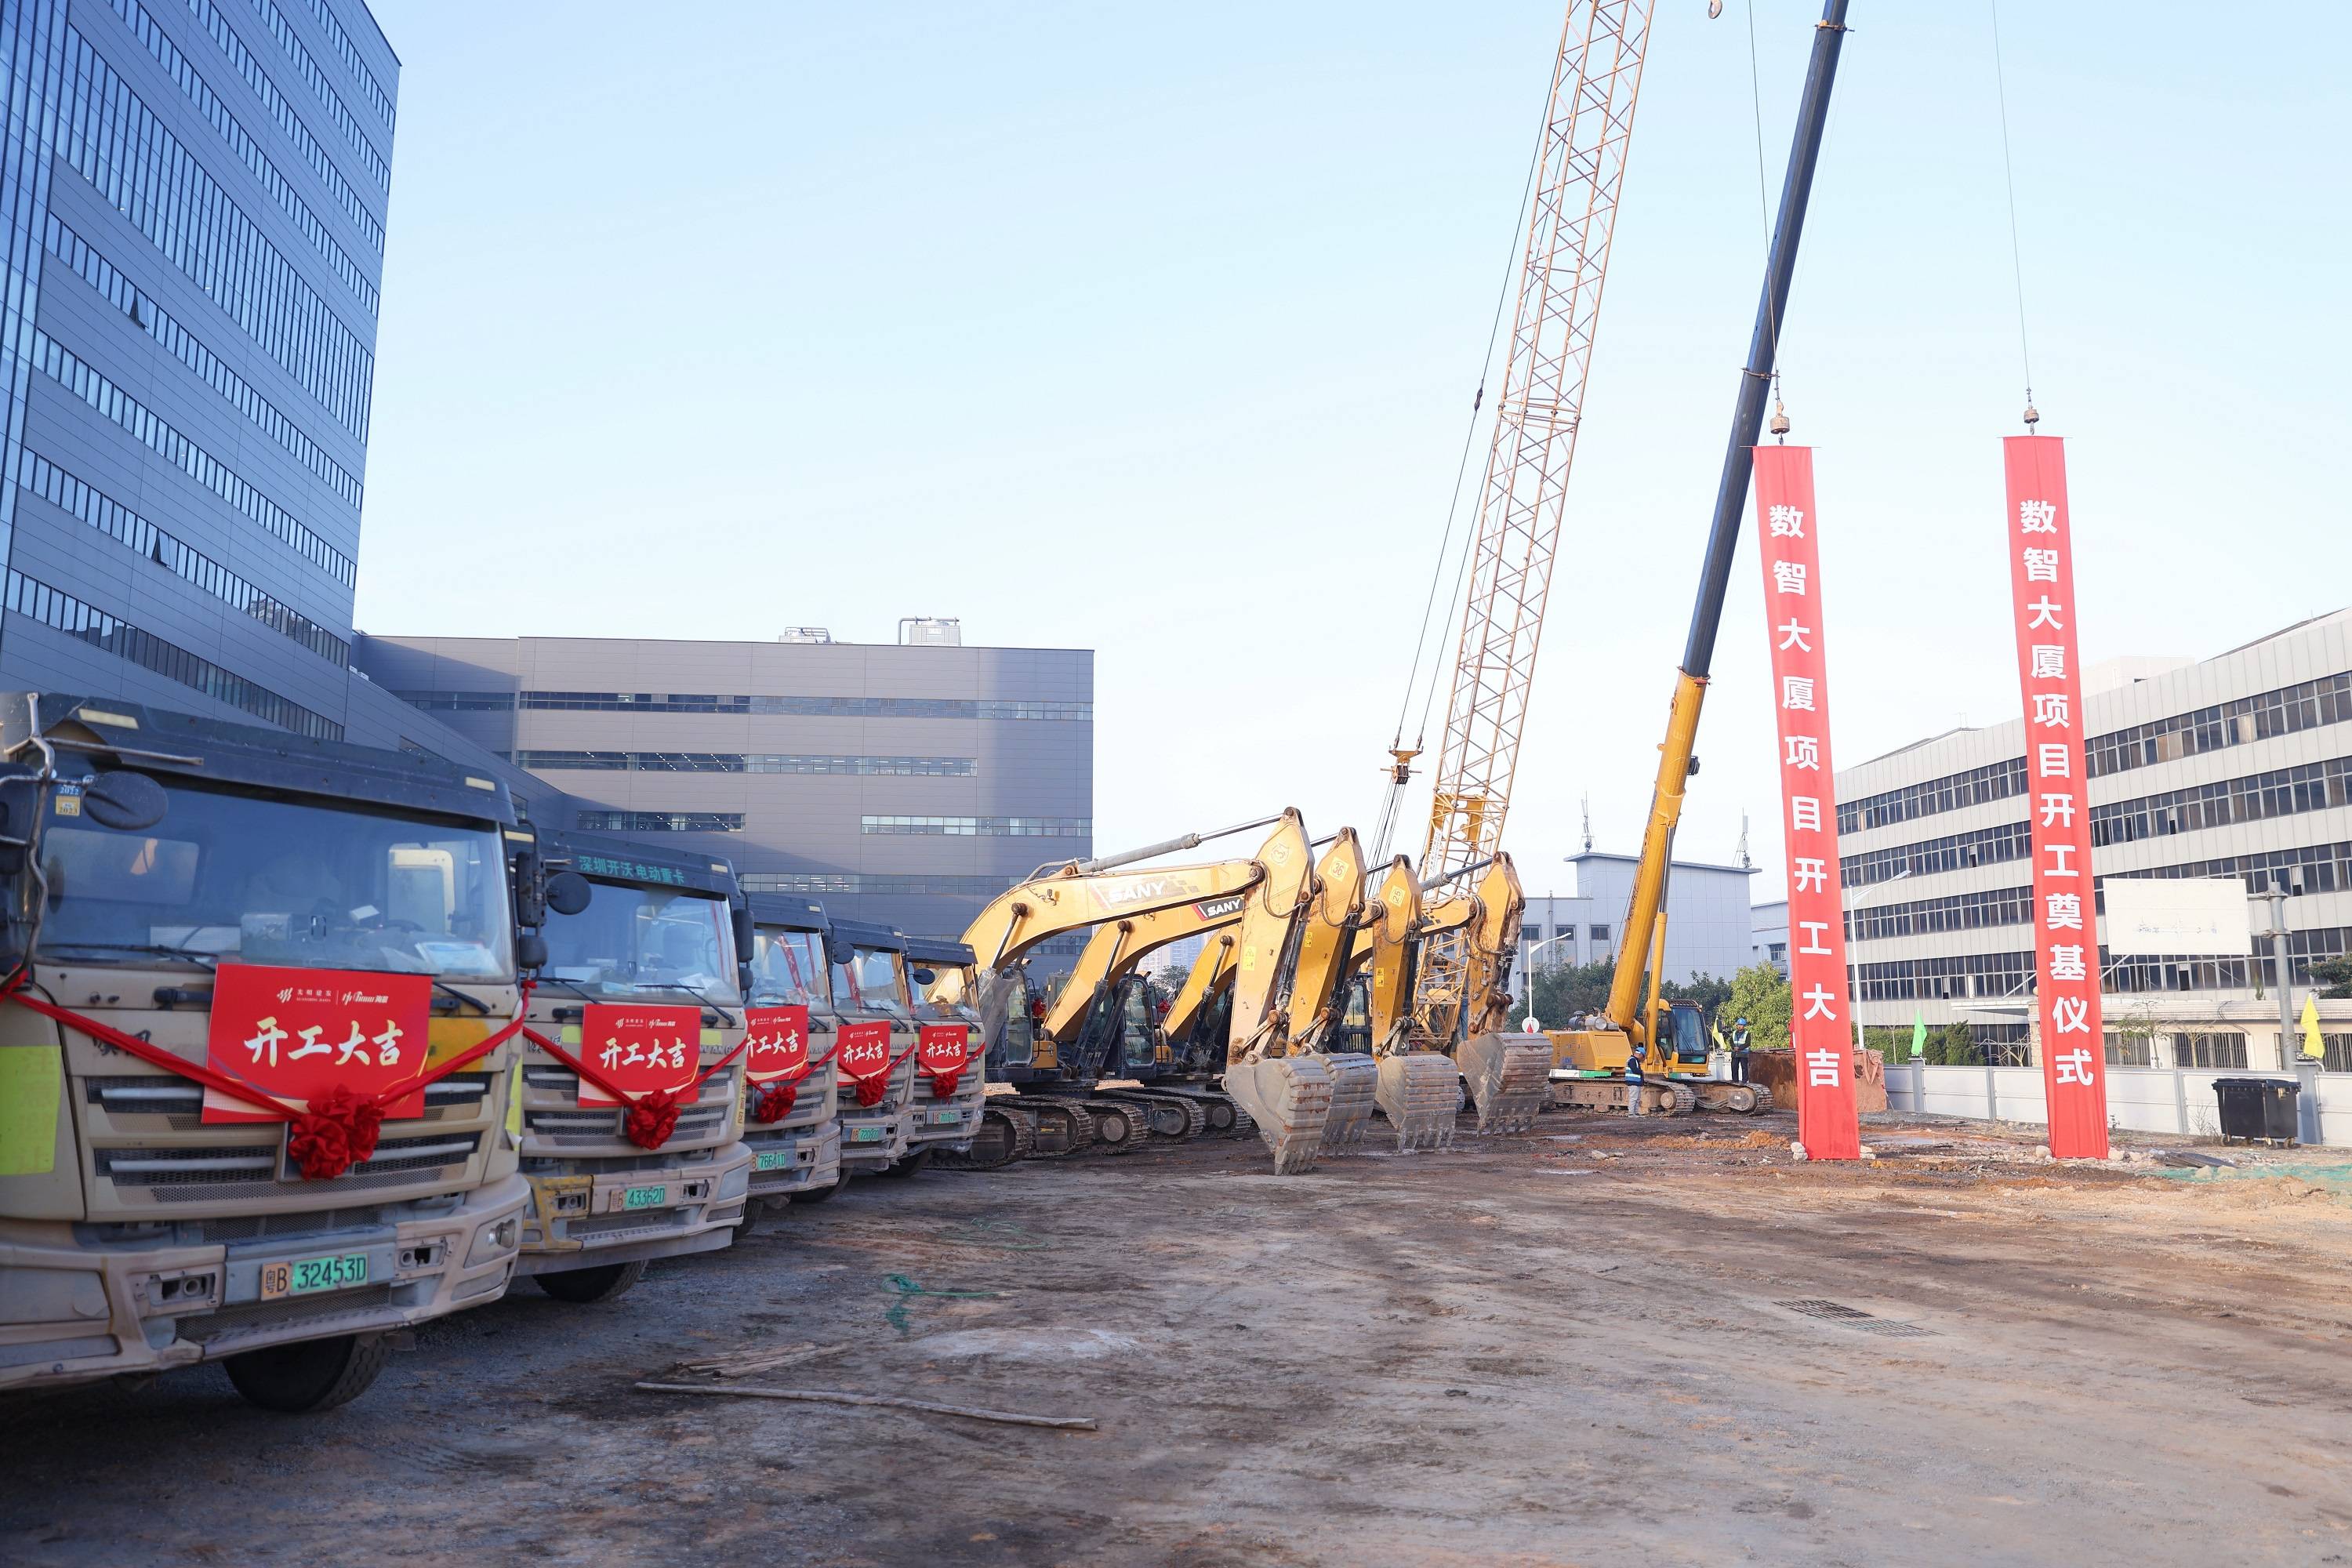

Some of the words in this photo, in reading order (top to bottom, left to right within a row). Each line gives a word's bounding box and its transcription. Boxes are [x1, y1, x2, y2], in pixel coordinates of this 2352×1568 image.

[1769, 504, 1840, 1087] 数智大厦项目开工大吉
[2020, 499, 2094, 1087] 数智大厦项目开工奠基仪式
[578, 855, 685, 885] 深圳开沃电动重卡
[1332, 862, 1345, 876] 36
[1109, 880, 1166, 902] SANY
[1207, 898, 1241, 917] SANY
[244, 1016, 404, 1067] 开工大吉
[599, 1036, 687, 1071] 开工大吉
[843, 1040, 884, 1064] 开工大吉
[926, 1040, 961, 1058] 开工大吉
[297, 1257, 366, 1290] 32453D
